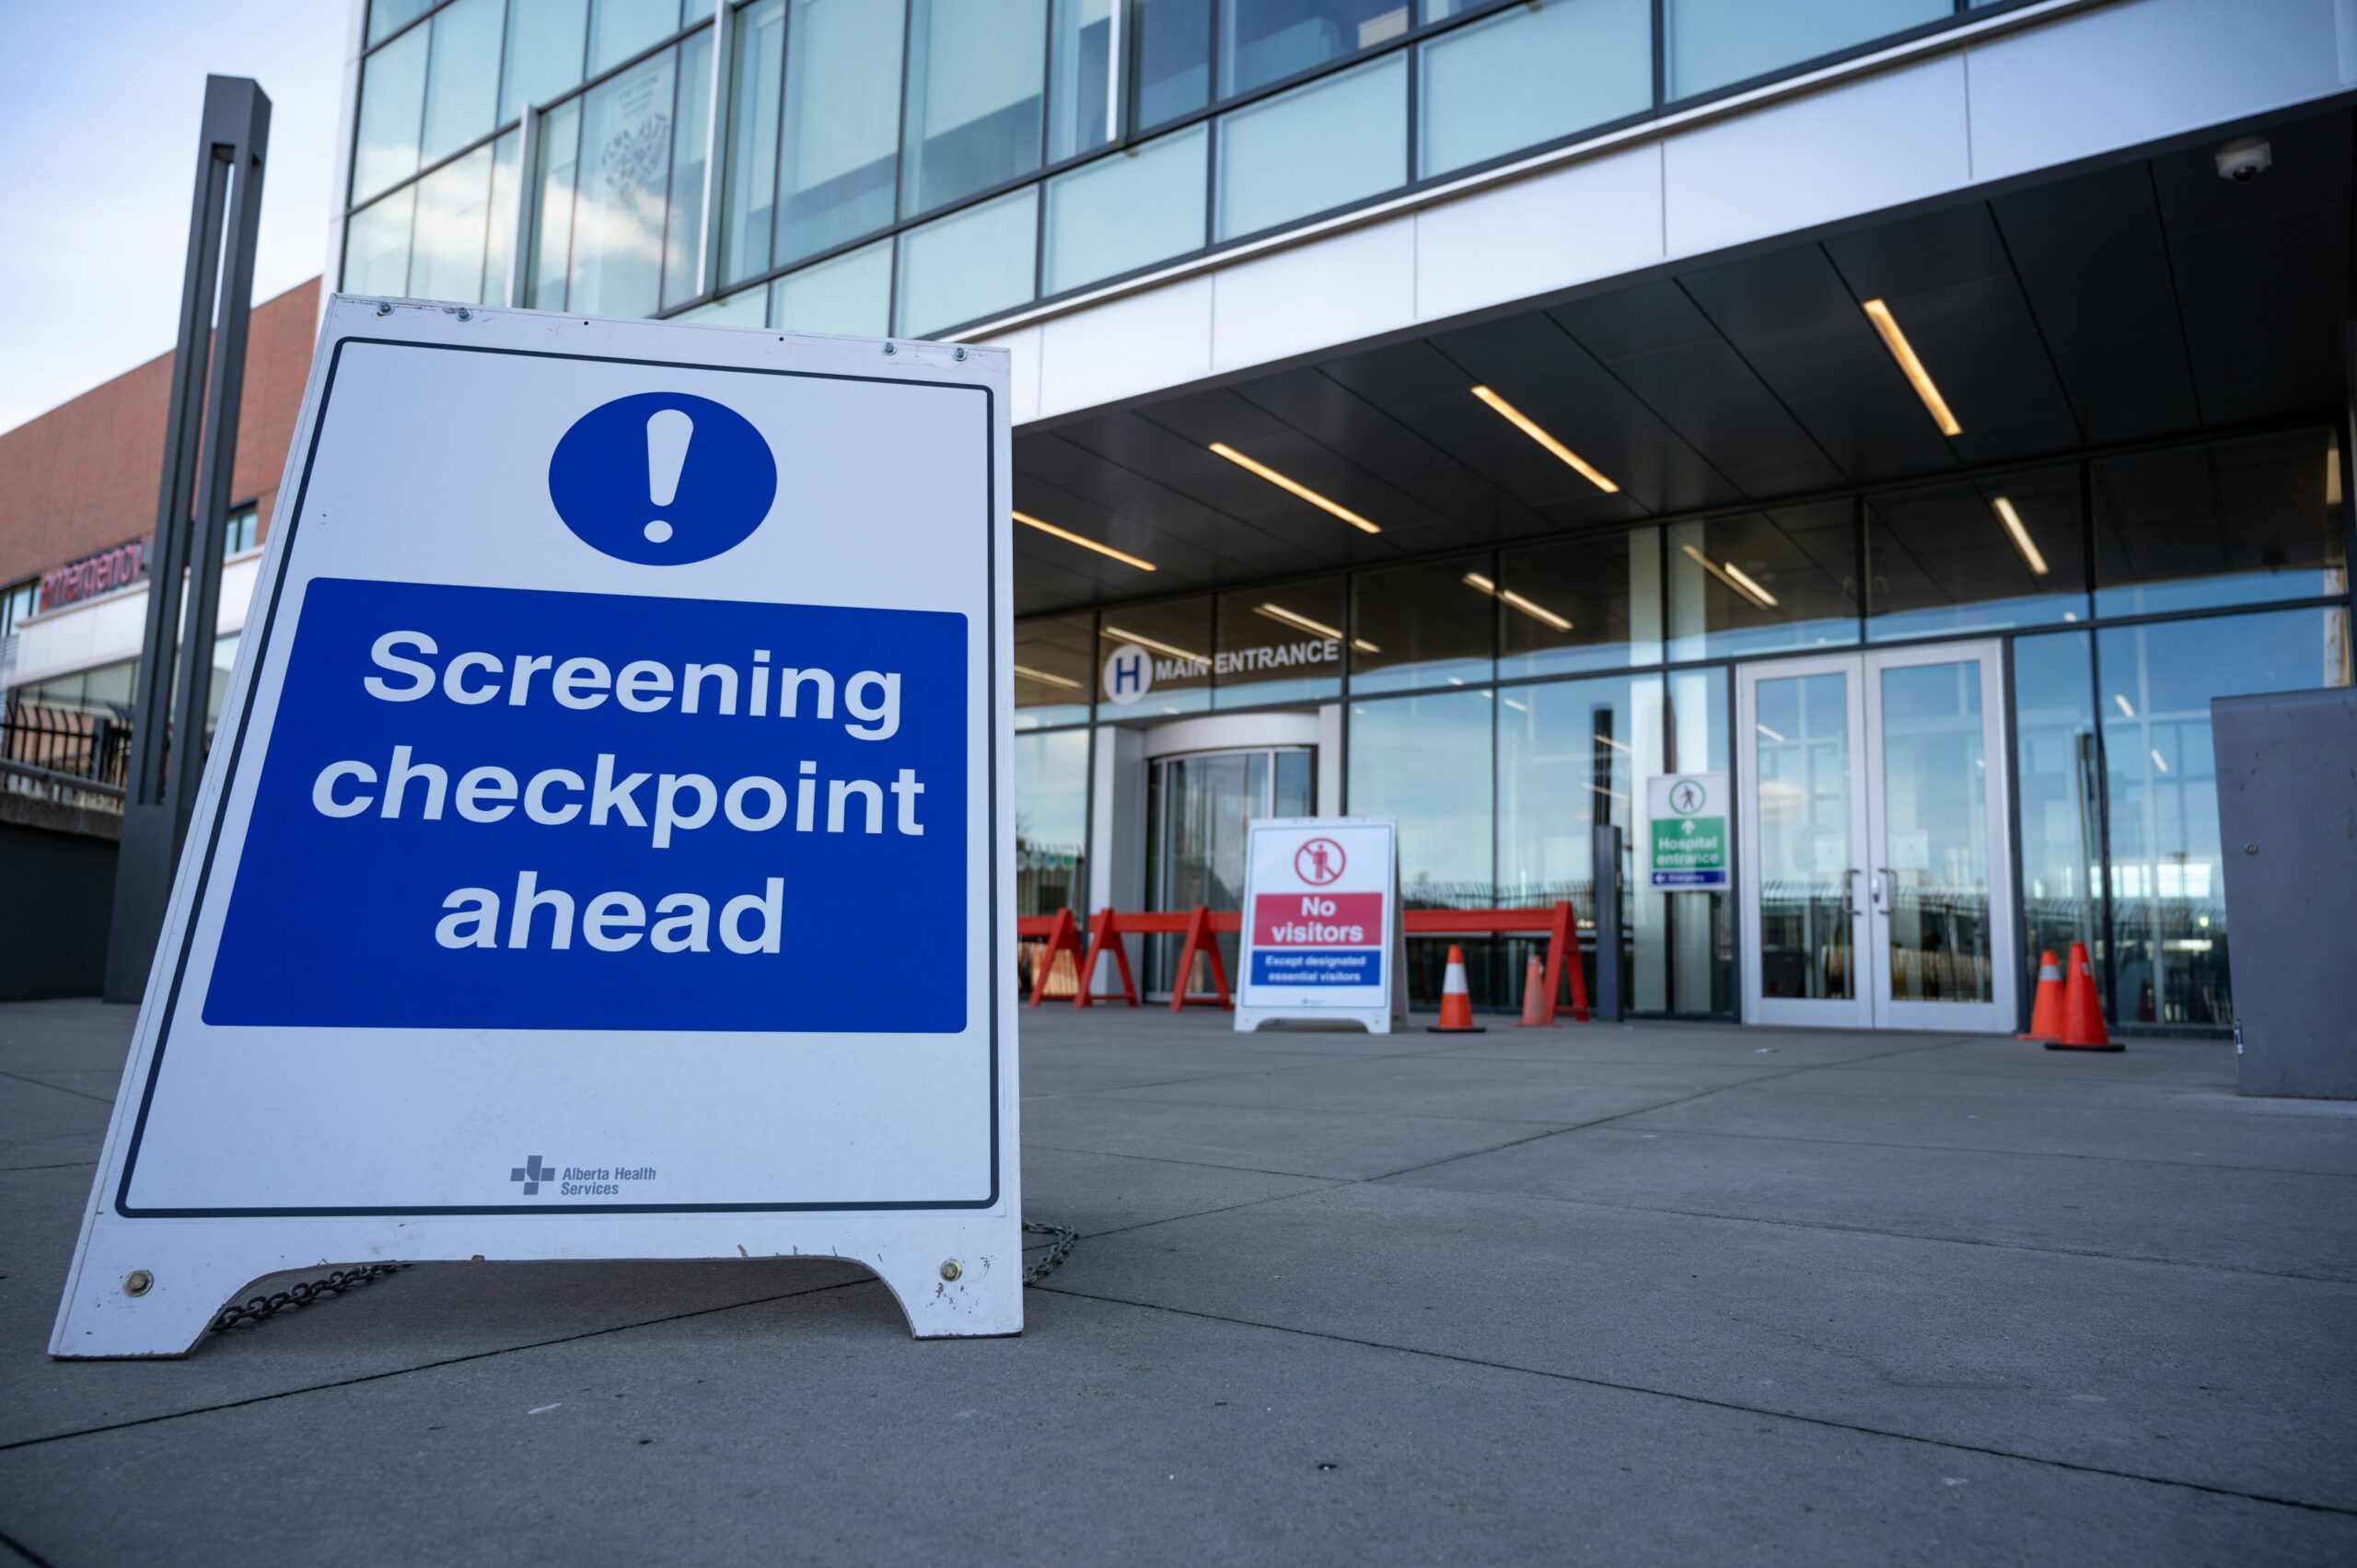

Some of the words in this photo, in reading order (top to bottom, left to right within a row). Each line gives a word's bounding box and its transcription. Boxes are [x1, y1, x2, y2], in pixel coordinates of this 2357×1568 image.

[1155, 655, 1207, 681] MAIN
[1214, 639, 1339, 674] ENTRANCE
[1115, 654, 1141, 695] H
[364, 630, 901, 741] Screening
[311, 744, 925, 849] checkpoint
[1659, 836, 1716, 852] Hospital
[1657, 853, 1718, 865] entrance
[435, 870, 784, 955] ahead
[1300, 897, 1337, 917] No
[1271, 922, 1364, 943] visitors
[1265, 955, 1303, 968] Except
[1305, 955, 1366, 969] designated
[1268, 970, 1318, 982] essential
[1319, 970, 1362, 982] visitors
[562, 1167, 610, 1180] Alberta
[614, 1167, 656, 1180] Health
[561, 1181, 620, 1196] Services
